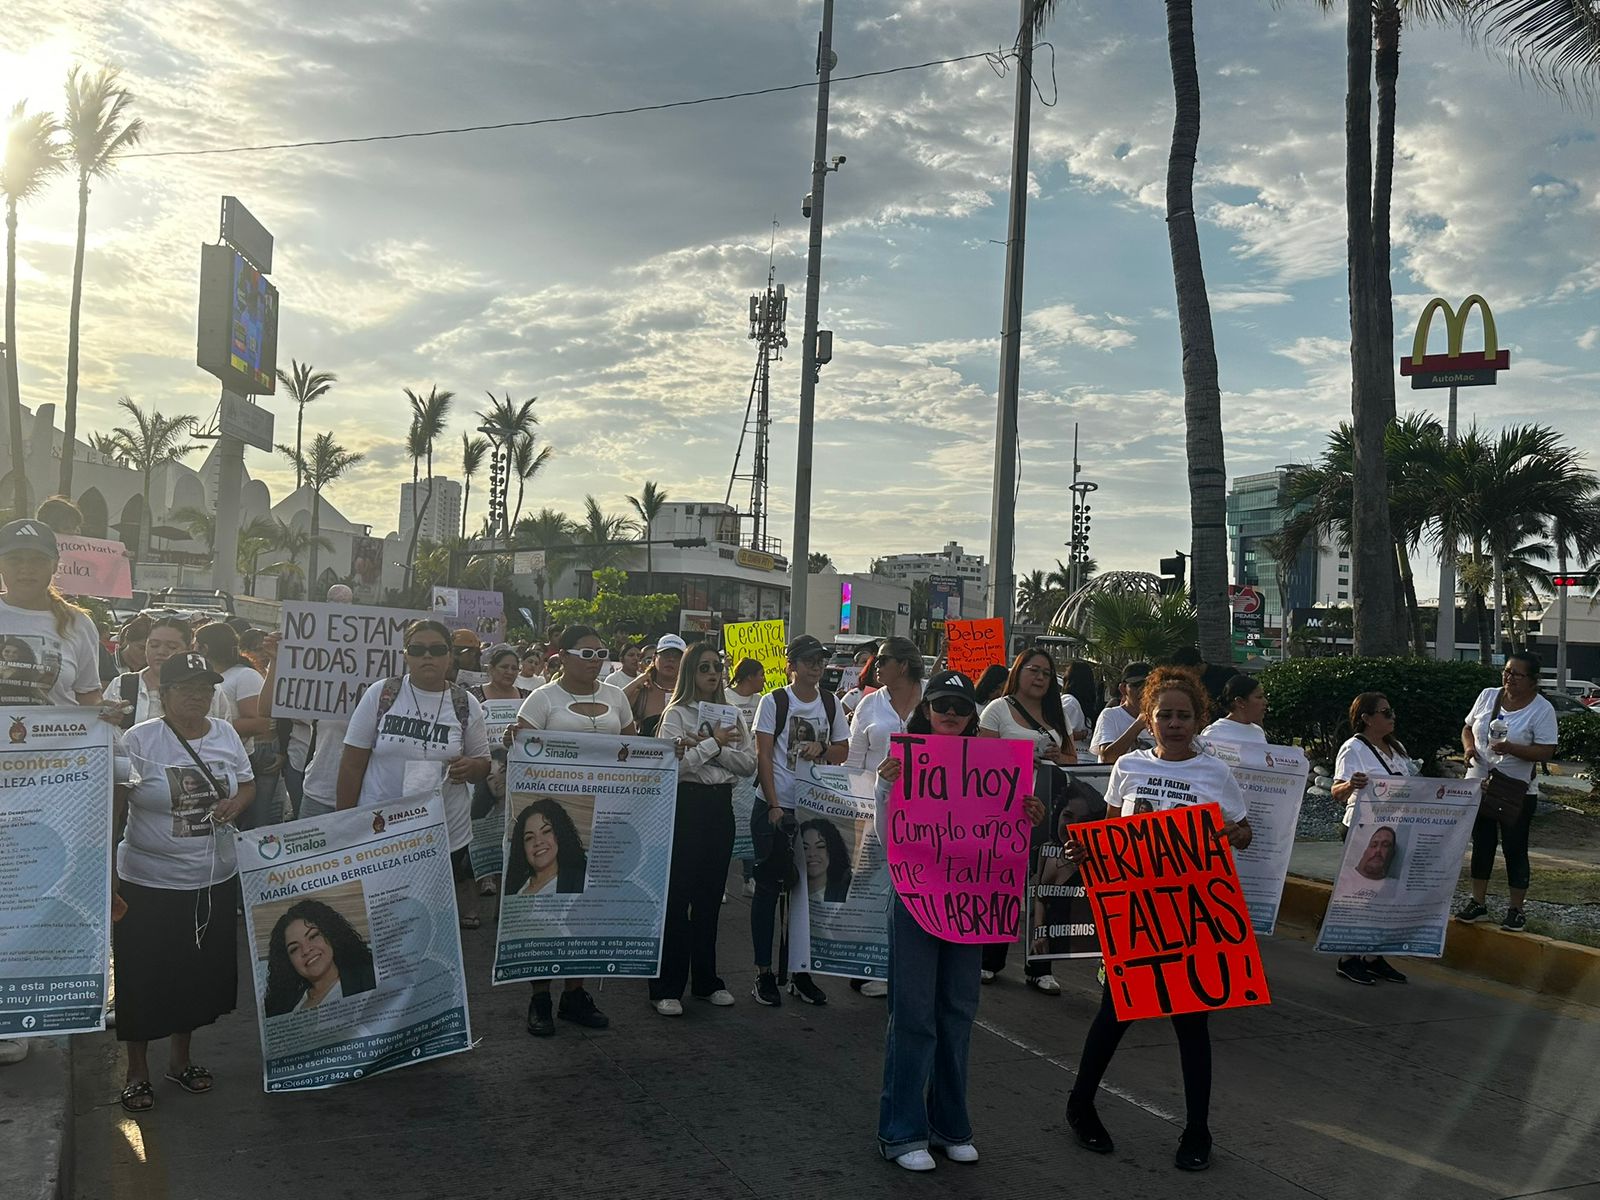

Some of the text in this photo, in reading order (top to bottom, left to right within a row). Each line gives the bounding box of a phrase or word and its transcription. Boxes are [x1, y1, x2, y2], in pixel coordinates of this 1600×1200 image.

[1432, 374, 1474, 383] AutoMac
[284, 611, 417, 646] NO ESTAM
[727, 622, 783, 648] Cecilia
[947, 621, 995, 641] Bebe
[285, 645, 359, 677] TODAS,
[275, 677, 348, 714] CECILIA
[32, 723, 87, 732] SINALOA
[380, 714, 450, 744] BROOKLYN
[381, 735, 405, 744] NEW
[545, 748, 578, 759] Sinaloa
[1217, 752, 1240, 762] Sinaloa
[0, 755, 87, 771] contrar a
[41, 771, 89, 785] FLORES
[524, 766, 584, 780] Ayúdanos
[587, 772, 594, 780] a
[597, 772, 649, 783] encontrar
[890, 736, 1021, 812] Tia hoy
[1252, 774, 1288, 784] encontrar
[515, 780, 661, 795] MARÍA CECILIA BERRELLEZA FLORES
[1164, 779, 1191, 791] FALTAN
[807, 787, 858, 807] Ayúdanos
[1136, 786, 1198, 803] CECILIA Y CRISTINA
[388, 806, 428, 821] SINALOA
[798, 797, 824, 812] MARÍA
[826, 806, 854, 817] CECILIA
[1386, 815, 1415, 824] ANTONIO
[892, 810, 1027, 864] Cumplo años
[284, 838, 327, 855] Sinaloa
[1042, 845, 1063, 859] HOY
[1071, 809, 1232, 887] HERMANA
[267, 855, 340, 885] Ayúdanos
[343, 855, 352, 864] a
[355, 838, 421, 862] encontrar
[260, 848, 437, 901] MARÍA CECILIA BERRELLEZA FLORES
[890, 861, 927, 889] me
[1037, 885, 1086, 898] QUEREMOS
[900, 893, 942, 932] TU
[945, 892, 1021, 937] ABRAZO
[1095, 877, 1246, 956] FALTAS
[1049, 923, 1095, 937] QUEREMOS
[568, 948, 588, 956] ayuda
[21, 982, 45, 991] esta
[50, 979, 99, 992] persona,
[7, 996, 31, 1006] muy
[367, 1032, 404, 1048] referente
[271, 1063, 295, 1075] llama
[357, 1050, 367, 1059] Tu
[315, 1074, 328, 1083] 327
[330, 1072, 349, 1080] 8424
